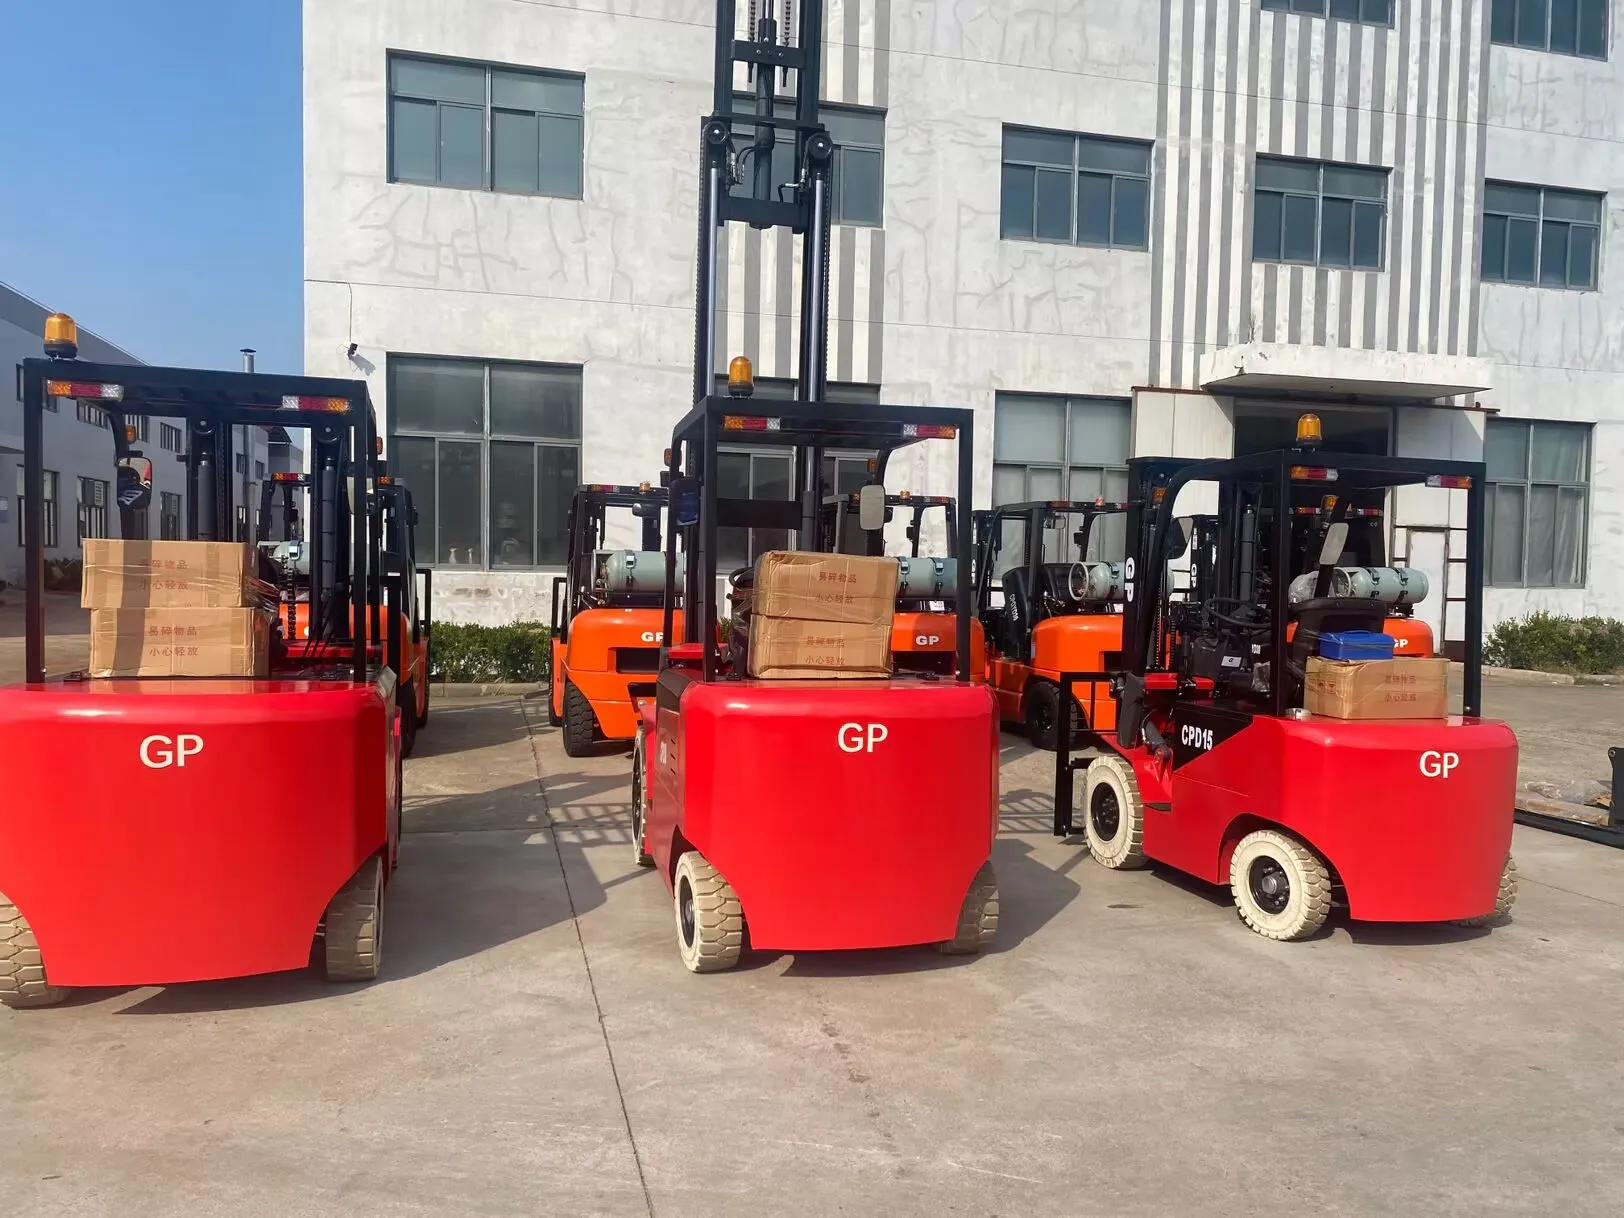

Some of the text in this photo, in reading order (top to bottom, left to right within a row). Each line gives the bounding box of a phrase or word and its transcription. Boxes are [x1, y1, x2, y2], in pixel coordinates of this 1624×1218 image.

[1125, 557, 1136, 602] GP
[148, 626, 198, 637] 易碎物品
[641, 631, 664, 642] GP
[915, 635, 940, 645] GP
[149, 646, 199, 657] 小心轻放
[837, 722, 888, 753] GP
[1181, 724, 1214, 750] CPD15
[139, 734, 204, 769] GP
[1419, 750, 1459, 778] GP
